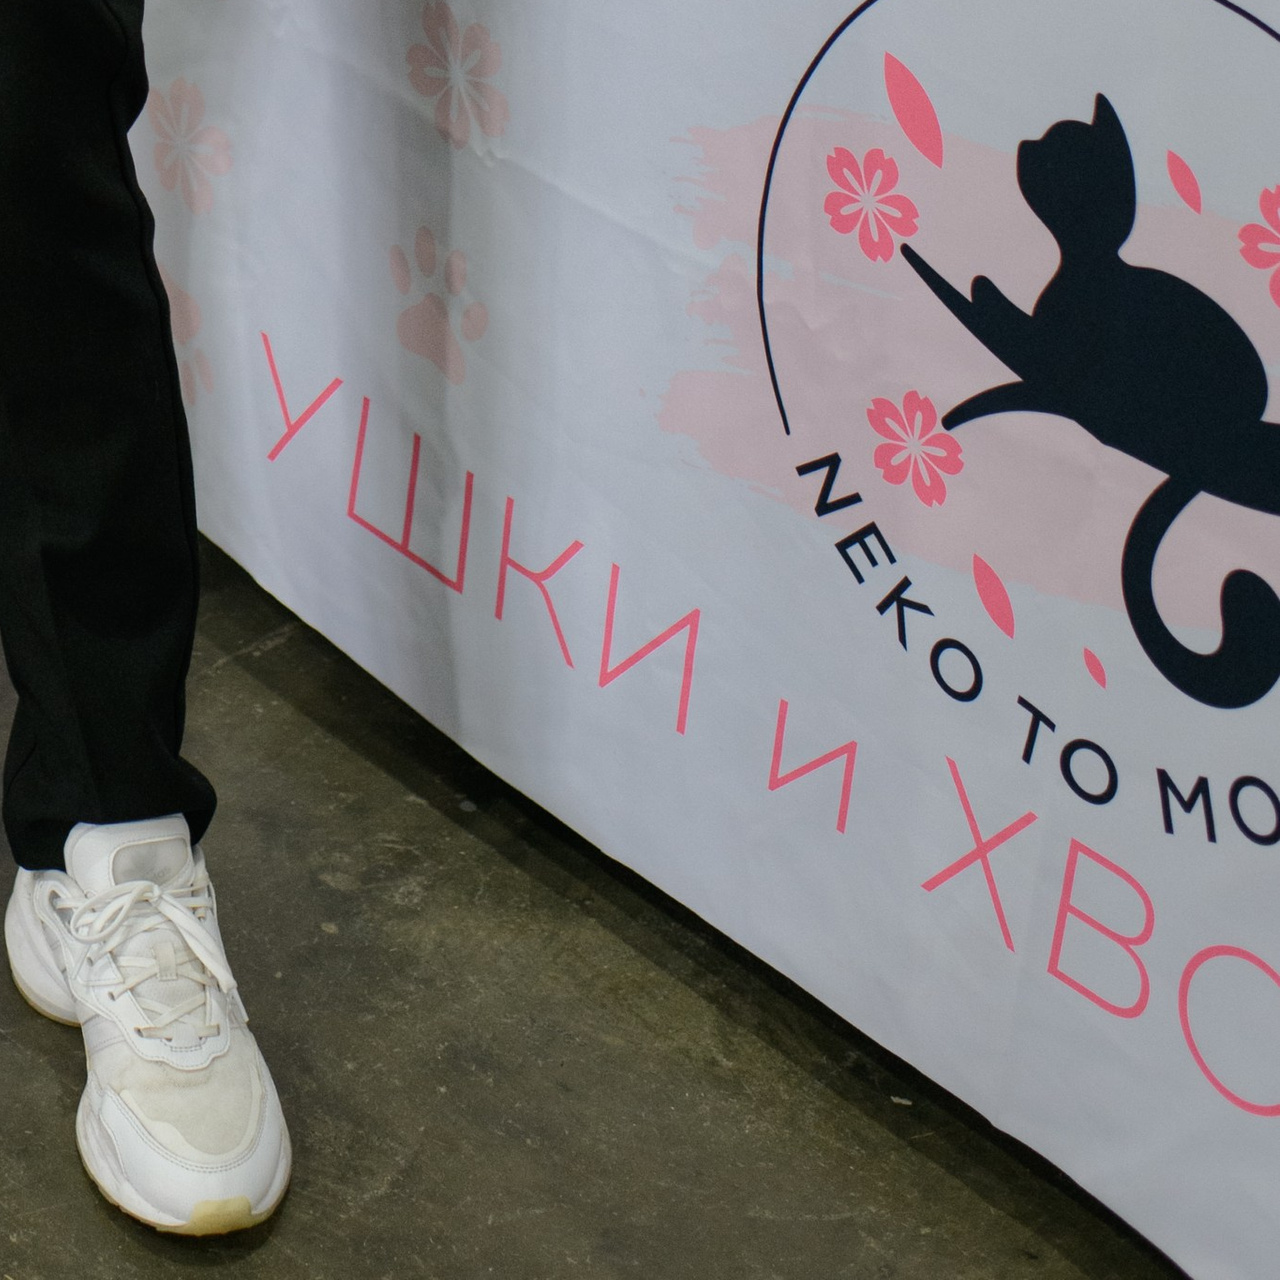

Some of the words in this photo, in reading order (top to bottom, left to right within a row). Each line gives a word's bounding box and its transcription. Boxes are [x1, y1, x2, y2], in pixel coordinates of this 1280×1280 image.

[260, 331, 701, 736] УШКИ
[768, 698, 858, 835] И
[795, 452, 984, 702] NEKO
